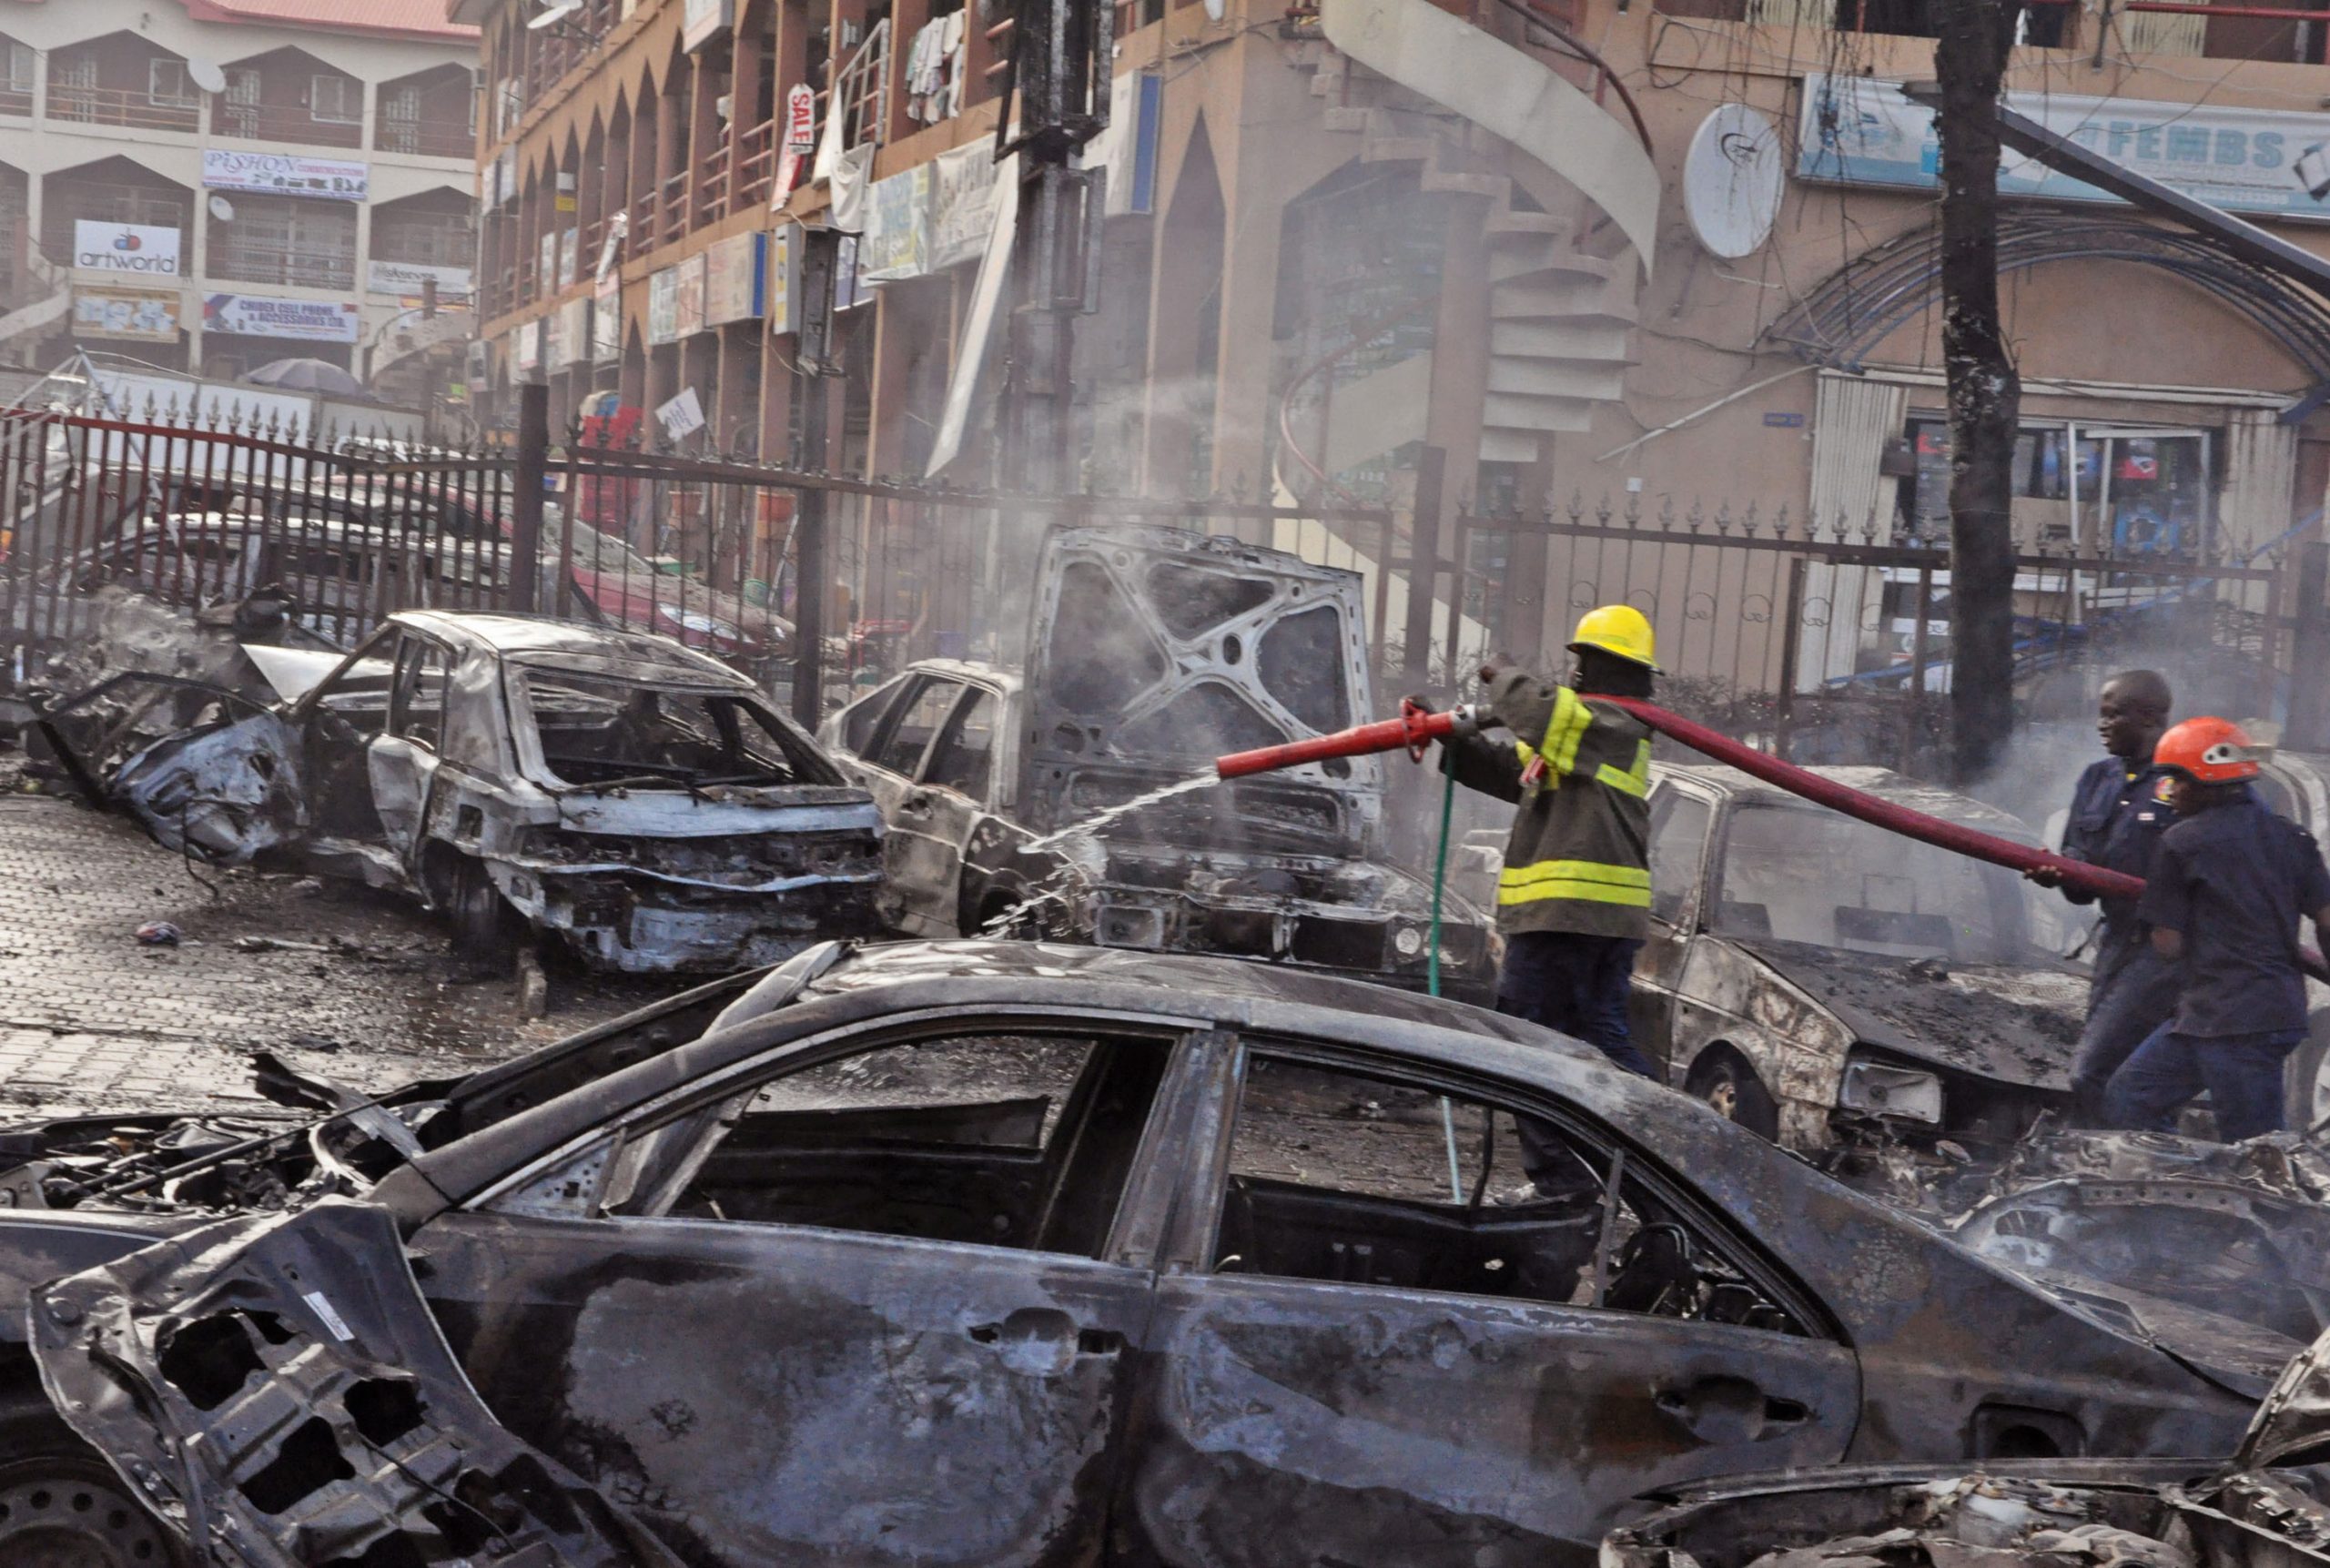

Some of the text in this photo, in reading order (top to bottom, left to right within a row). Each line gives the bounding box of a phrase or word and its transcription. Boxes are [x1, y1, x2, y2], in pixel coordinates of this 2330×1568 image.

[792, 93, 811, 142] SALE
[2108, 121, 2284, 168] FEMBS
[79, 252, 175, 273] artworld
